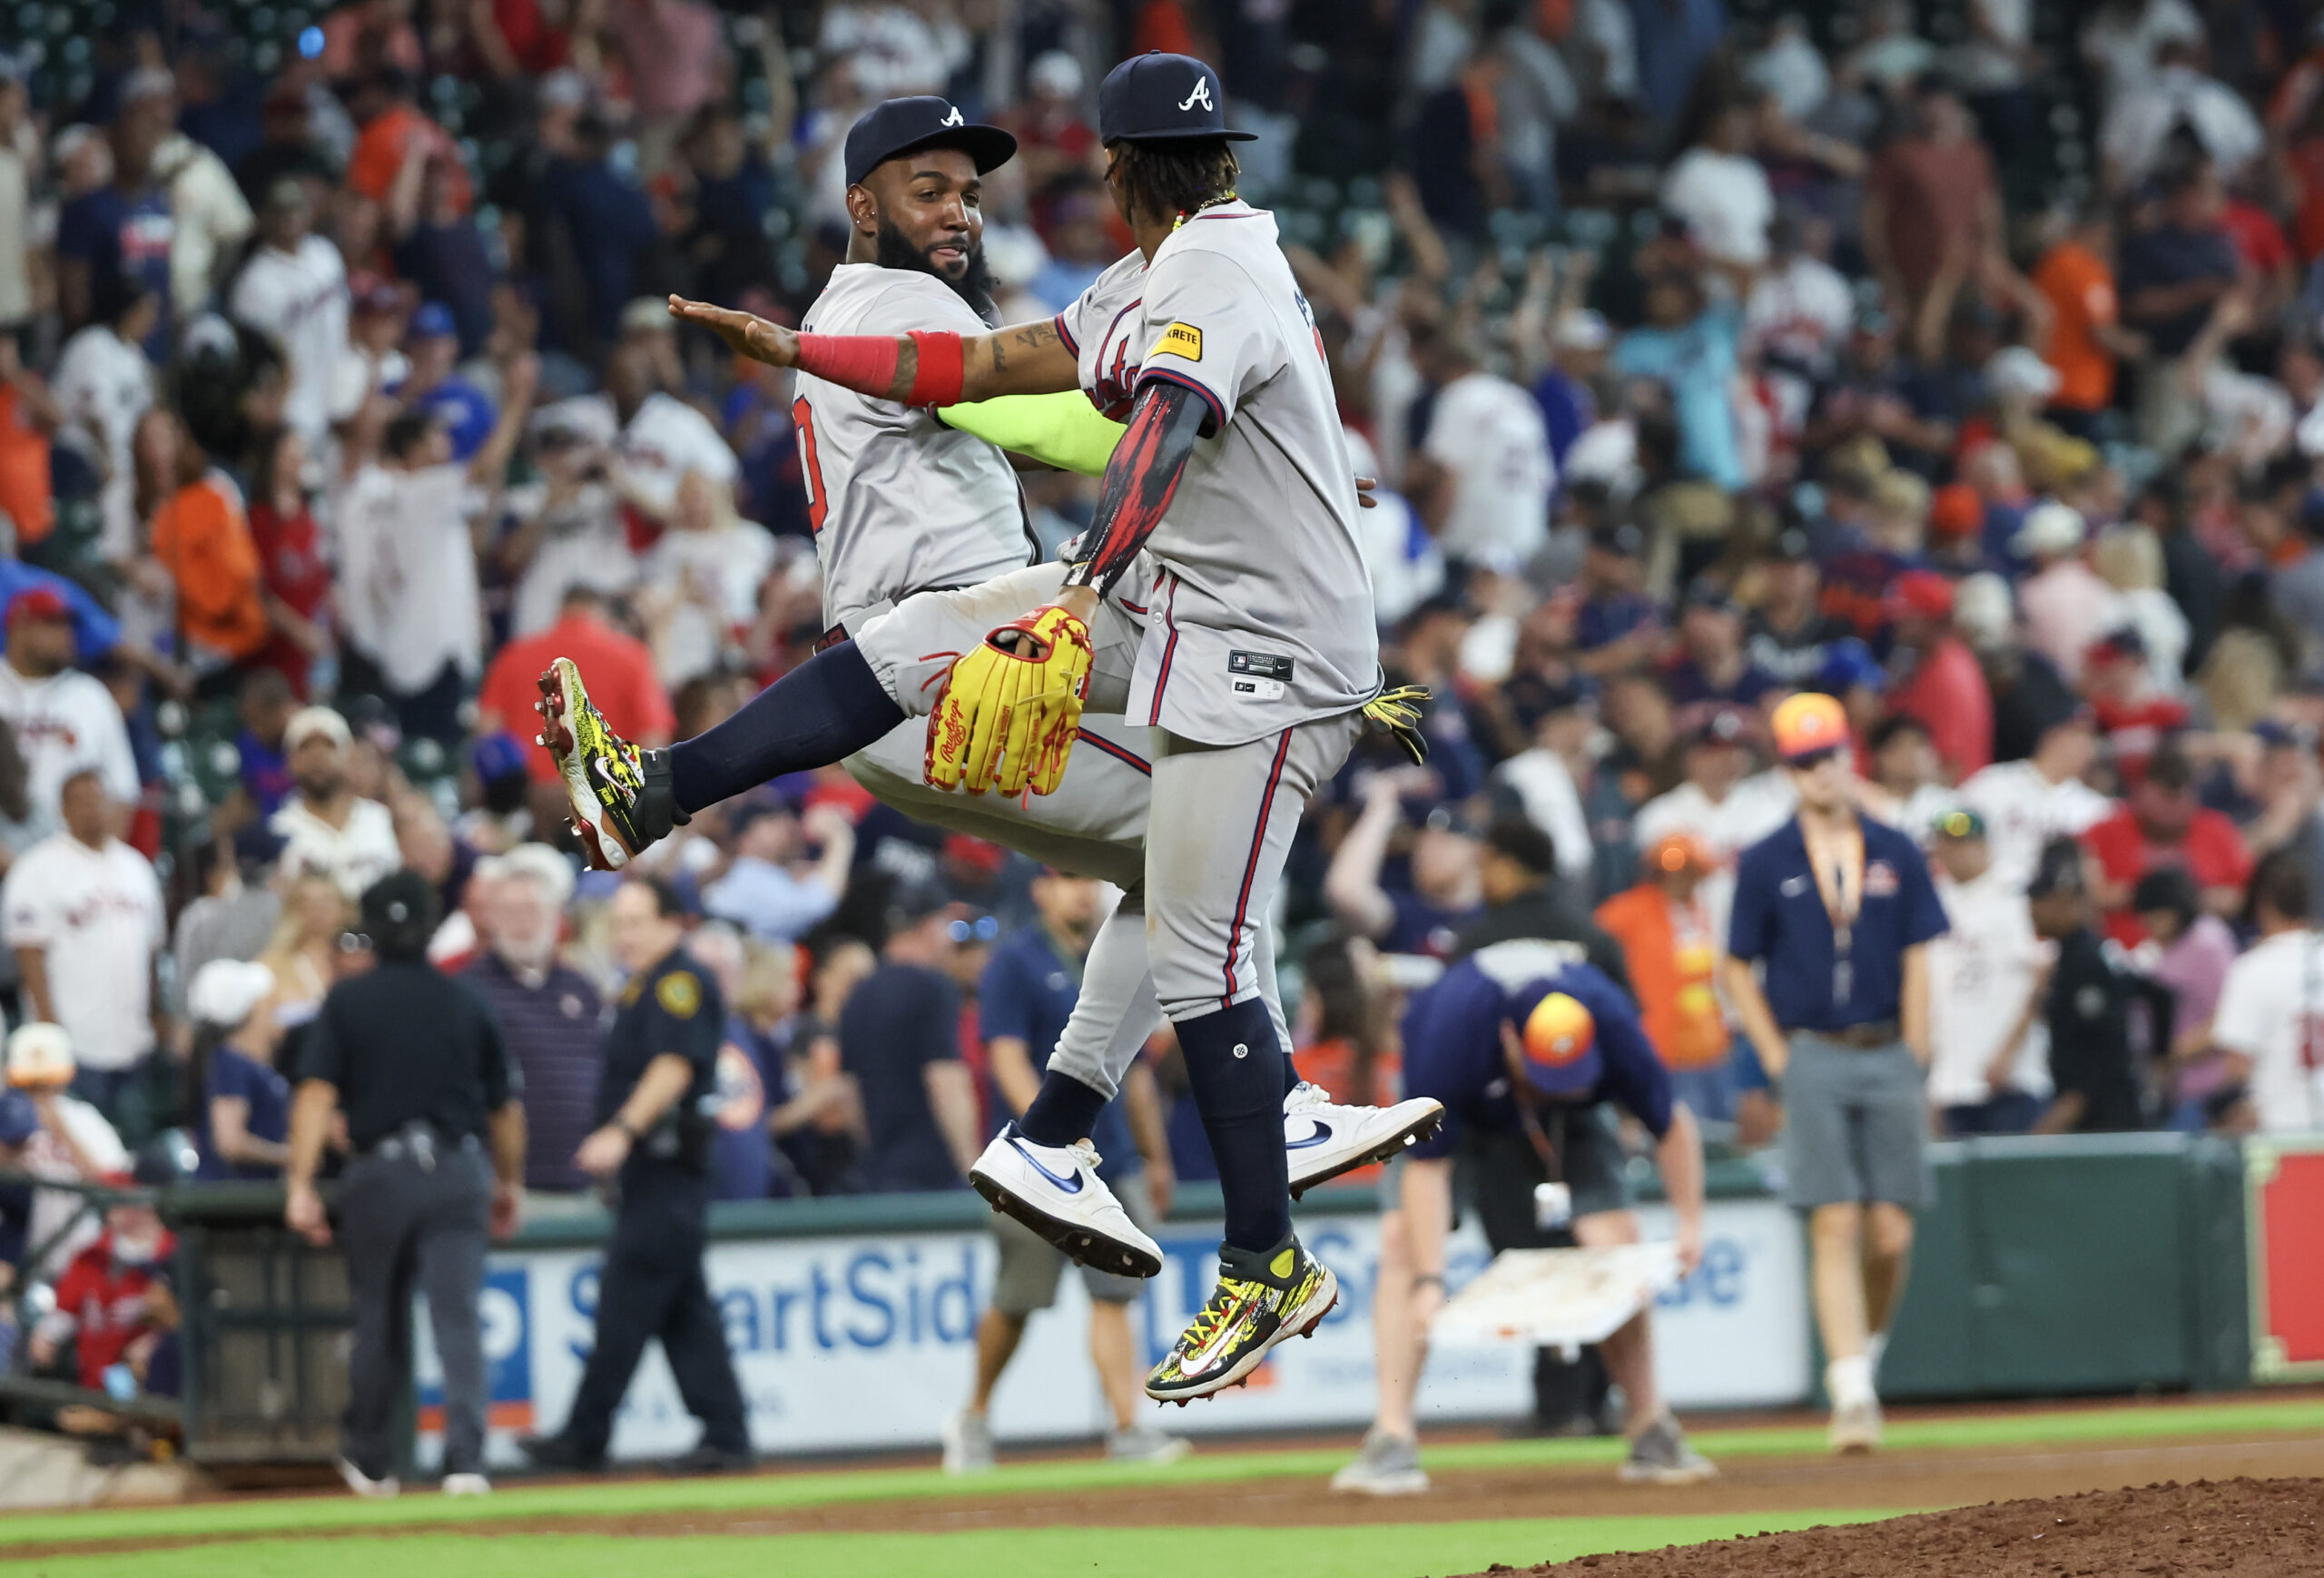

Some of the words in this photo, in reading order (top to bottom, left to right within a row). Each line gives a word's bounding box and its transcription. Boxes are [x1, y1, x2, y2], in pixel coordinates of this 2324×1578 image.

[1177, 75, 1214, 112] A
[1165, 328, 1198, 345] KRETE
[940, 697, 967, 764] Rawlings
[569, 1242, 979, 1364] SartSid
